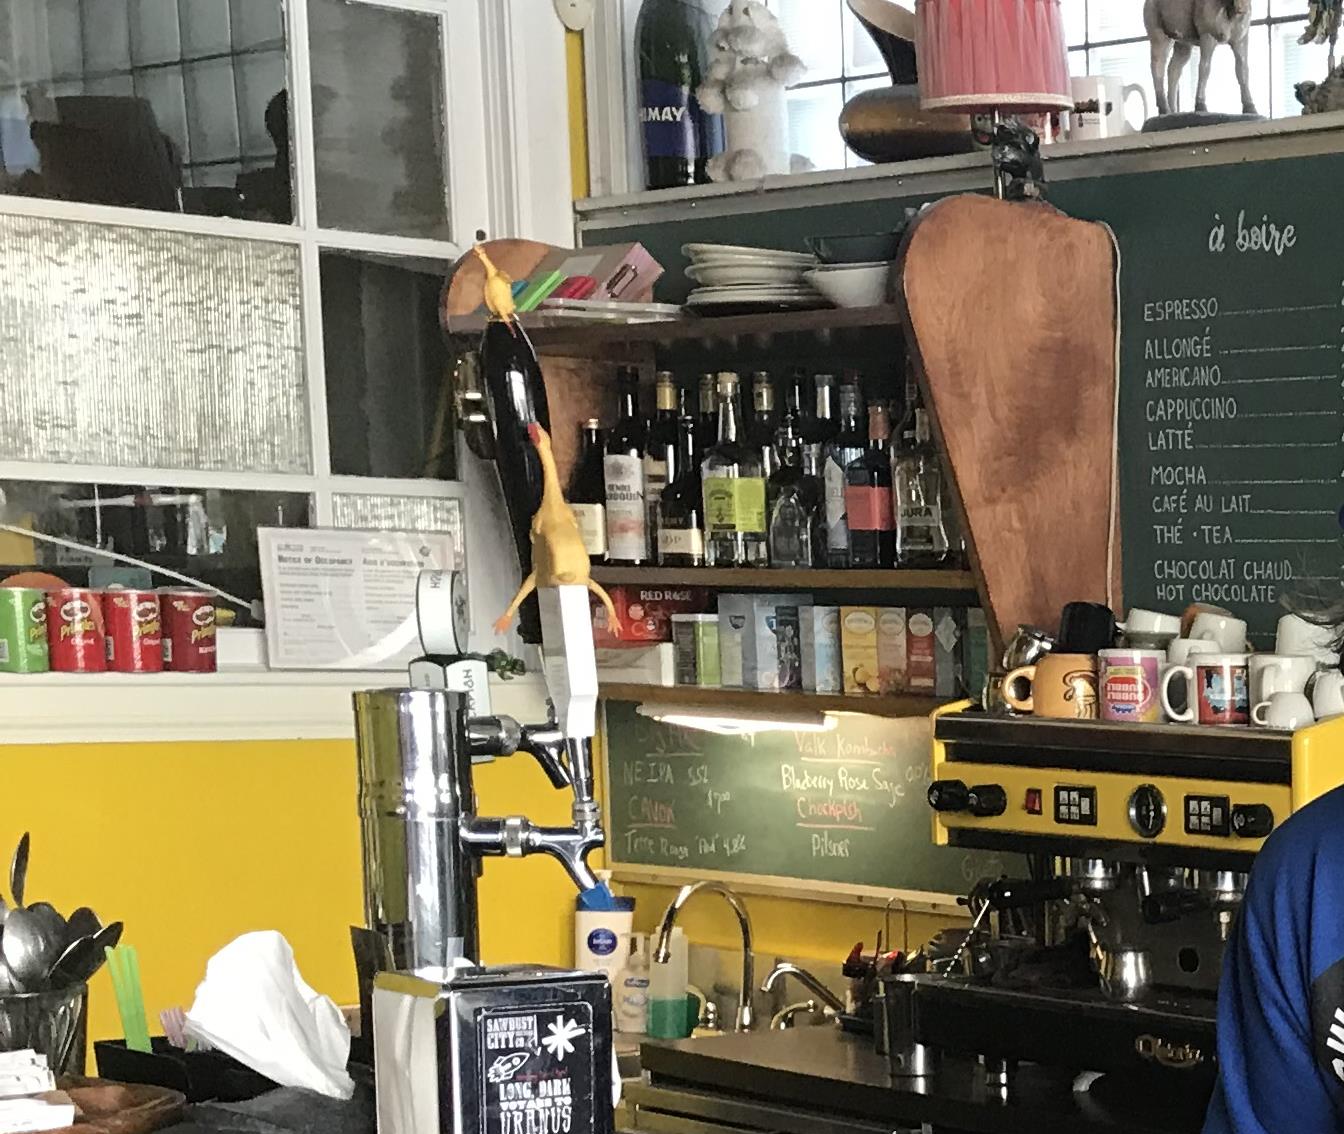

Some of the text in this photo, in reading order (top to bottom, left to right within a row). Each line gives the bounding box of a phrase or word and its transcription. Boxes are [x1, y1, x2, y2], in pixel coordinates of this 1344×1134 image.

[1236, 210, 1297, 255] boire
[1143, 298, 1219, 323] ESPRESSO
[1144, 326, 1212, 359] ALLONGÉ
[1145, 365, 1222, 388] AMERICANO
[1146, 397, 1237, 422] CAPPUCCINO
[1148, 421, 1195, 451] LATTÉ
[1150, 464, 1207, 485] MOCHA
[1152, 487, 1251, 513] CAFÉ AU LAIT
[899, 507, 934, 519] JURA
[1153, 517, 1233, 544] THÉ TEA
[1154, 558, 1293, 581] CHOCOLAT CHAUD
[640, 590, 664, 602] RED
[1156, 583, 1276, 603] HOT CHOCOLATE
[838, 766, 870, 793] Rose
[486, 1015, 535, 1032] SAWDUST
[487, 1032, 516, 1050] CITY
[539, 1078, 572, 1098] DARK
[499, 1096, 573, 1111] VOYAGE TO
